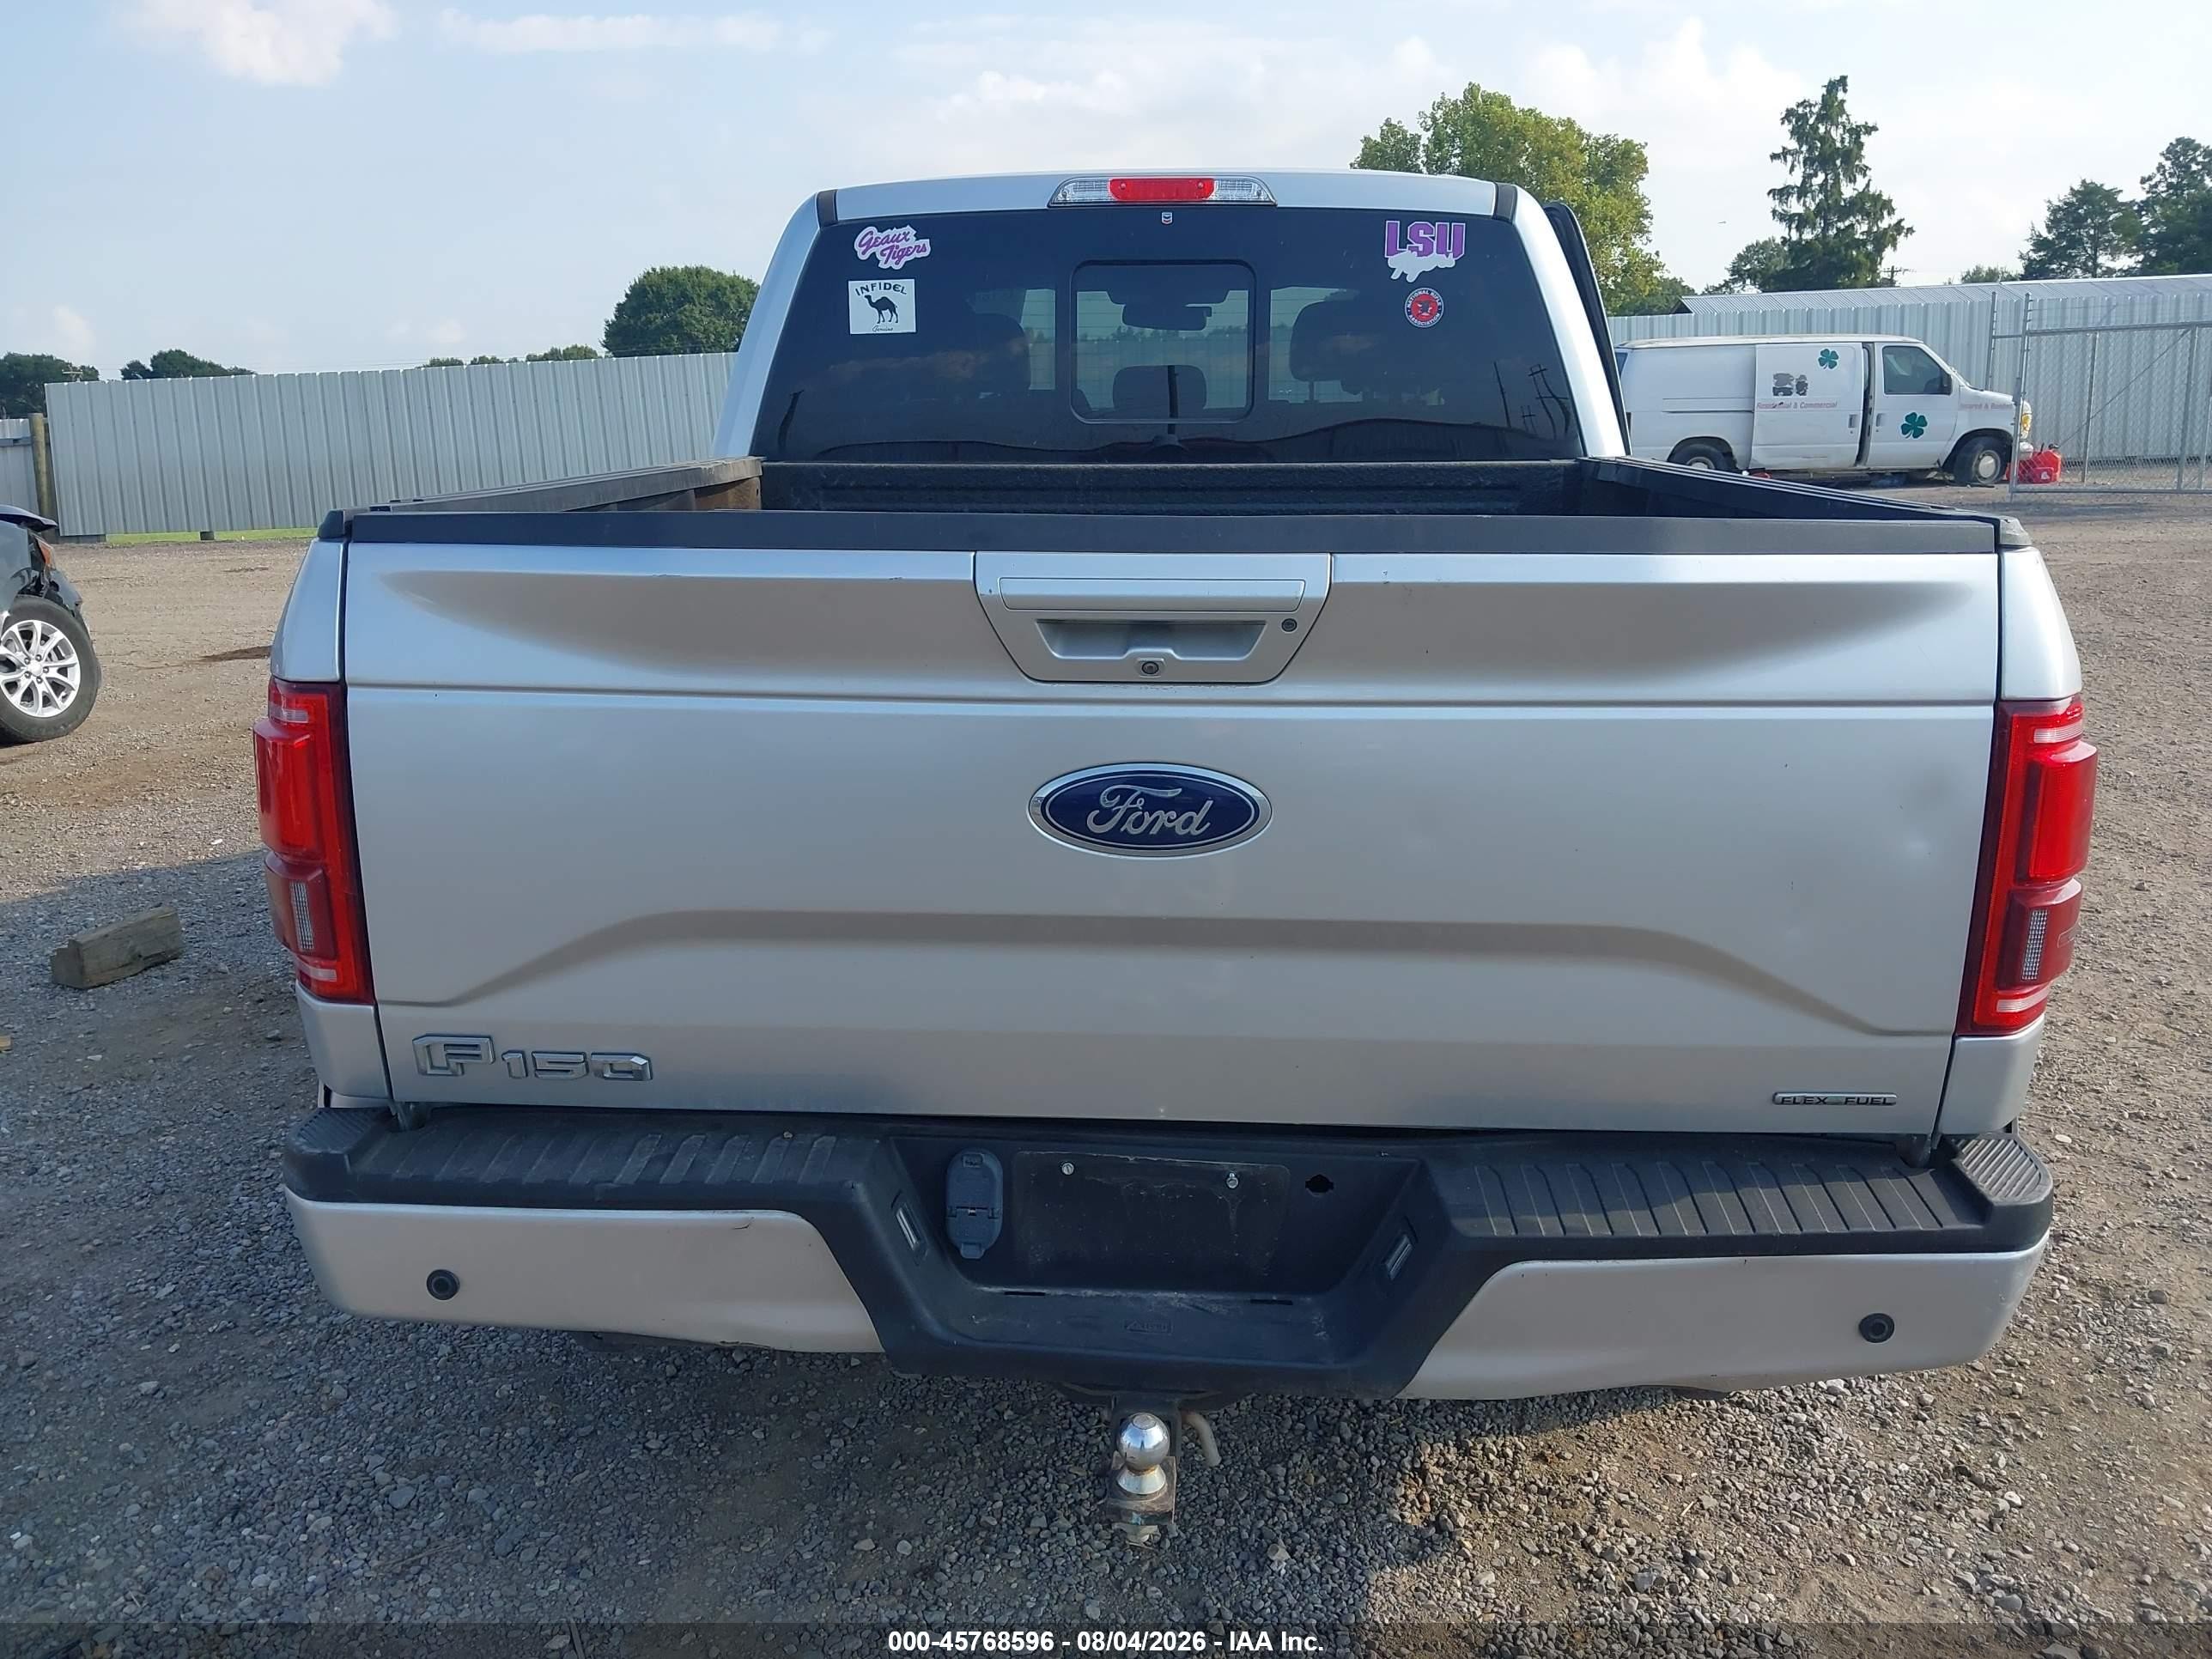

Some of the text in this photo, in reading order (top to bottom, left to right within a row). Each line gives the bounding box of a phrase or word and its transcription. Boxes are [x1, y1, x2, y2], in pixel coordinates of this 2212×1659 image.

[1384, 220, 1466, 259] LSU
[879, 242, 927, 265] Tigers
[854, 282, 908, 296] INFIDEL
[1407, 289, 1430, 308] NATIONAL
[1408, 313, 1441, 326] ASSOCIATION
[1086, 784, 1214, 836] Ford
[1780, 1097, 1894, 1106] FLEX FUEL
